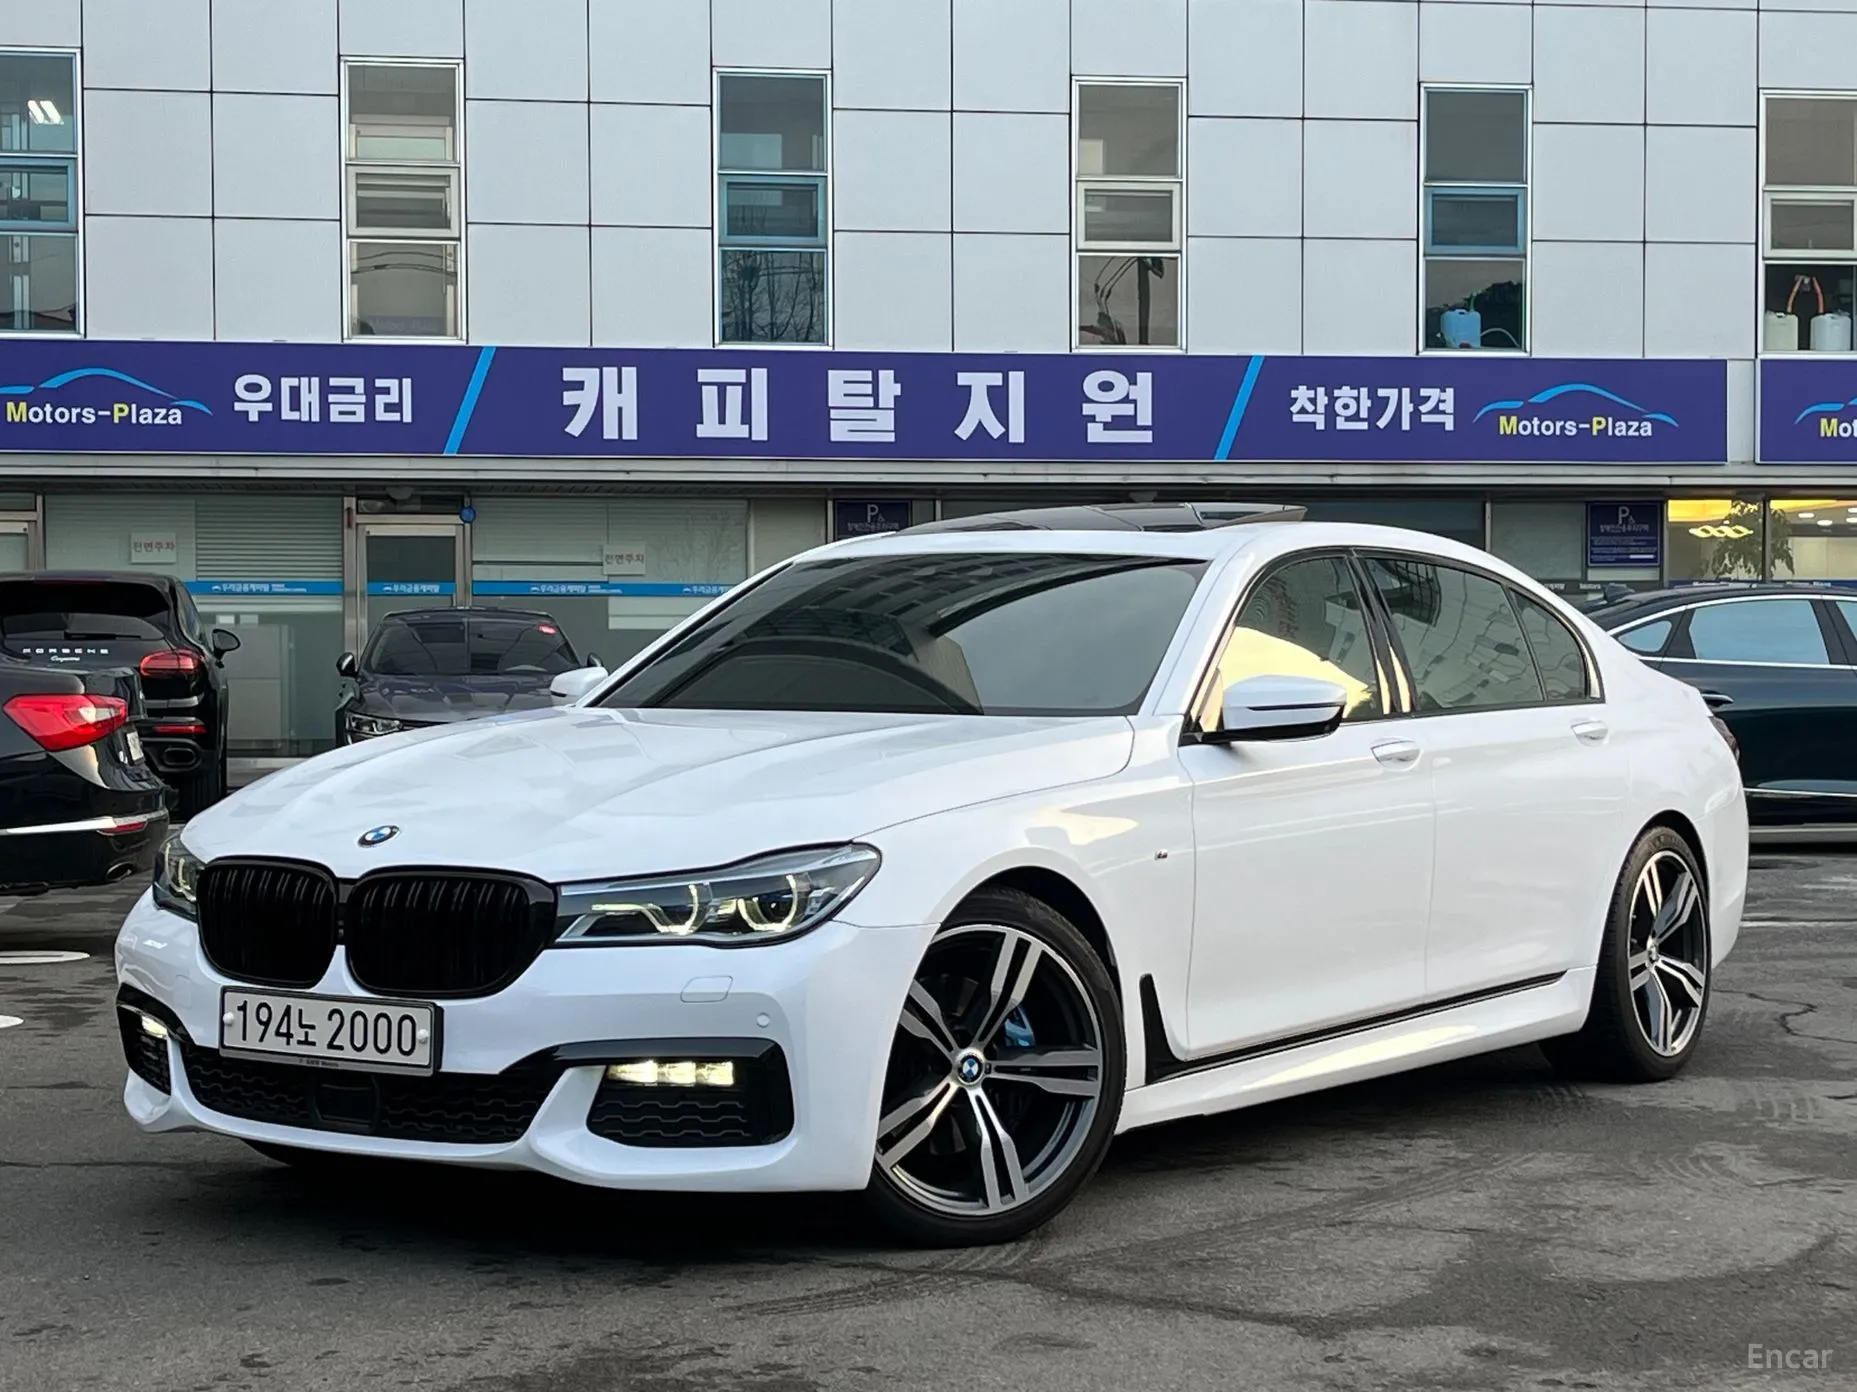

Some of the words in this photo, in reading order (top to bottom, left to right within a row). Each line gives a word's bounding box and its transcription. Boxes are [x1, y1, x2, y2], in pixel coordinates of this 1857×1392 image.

[6, 402, 183, 425] Motors-Plaza
[233, 375, 412, 423] 우대금리
[1289, 385, 1454, 431] 착한가격
[1499, 415, 1653, 437] Motors-Plaza
[1617, 506, 1630, 525] P
[237, 999, 317, 1047] 194노
[326, 1007, 417, 1057] 2000
